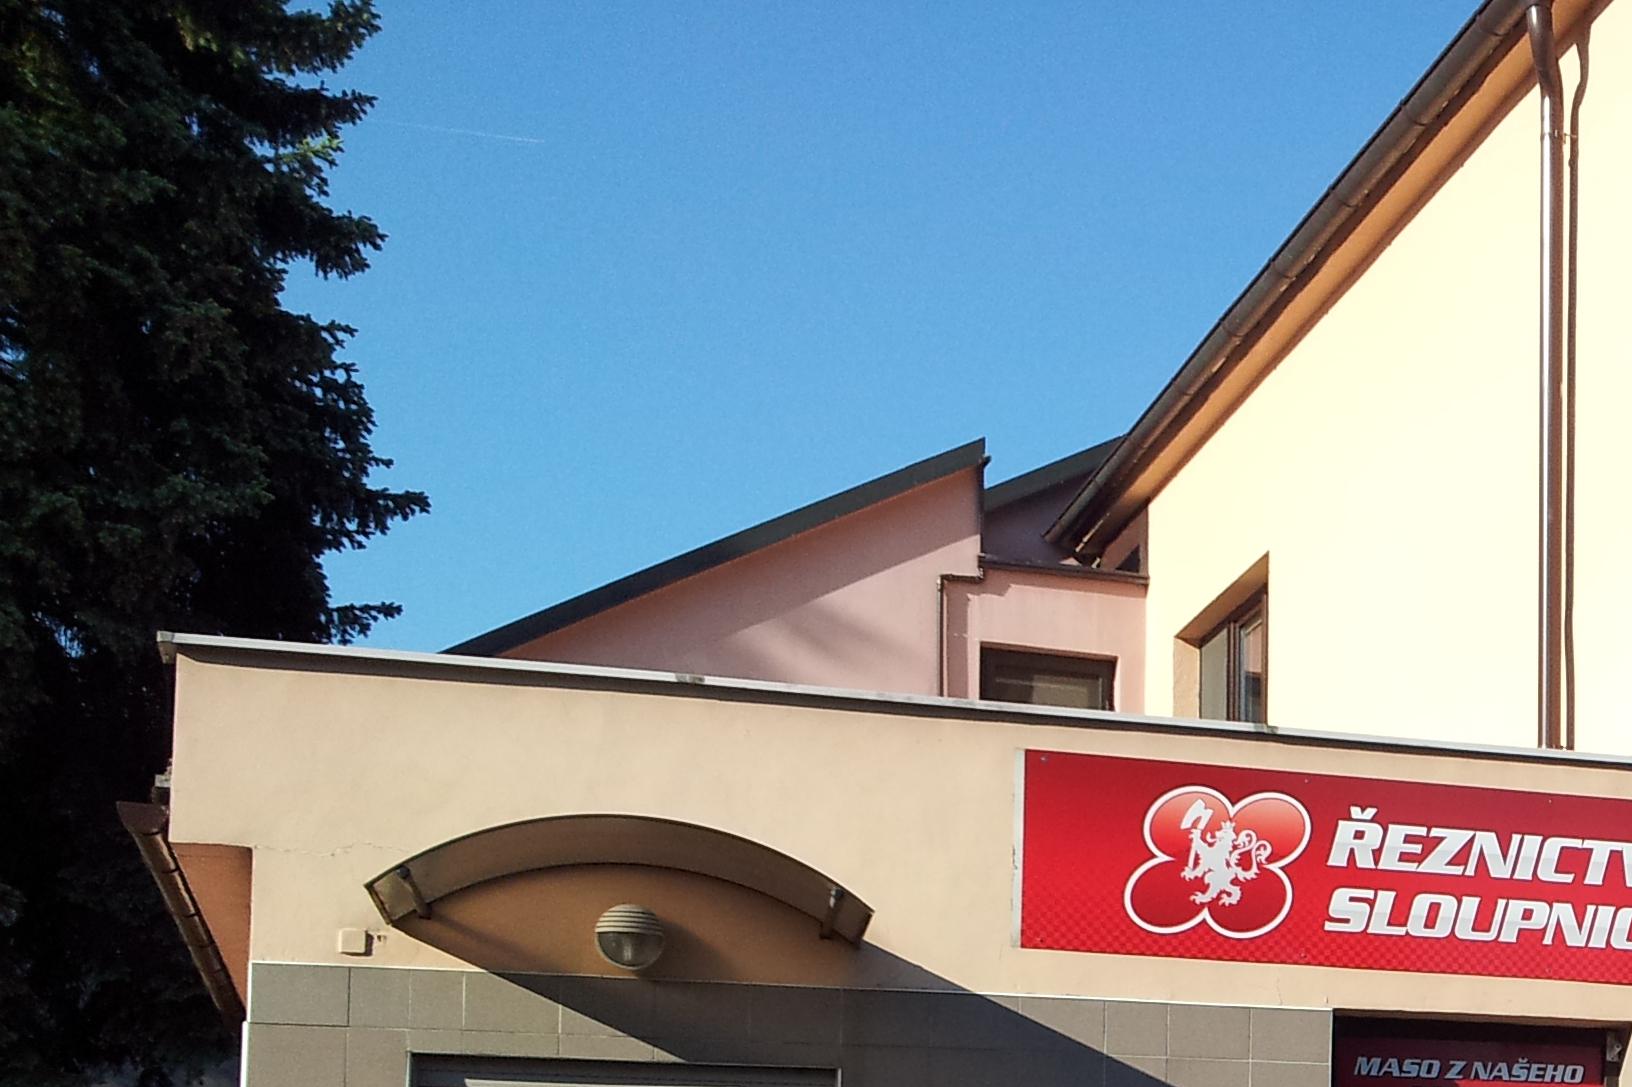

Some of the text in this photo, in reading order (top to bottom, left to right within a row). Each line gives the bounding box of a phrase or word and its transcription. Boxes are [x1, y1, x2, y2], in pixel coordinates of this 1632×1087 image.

[1354, 1056, 1585, 1084] MASO Z NAŠEHO
